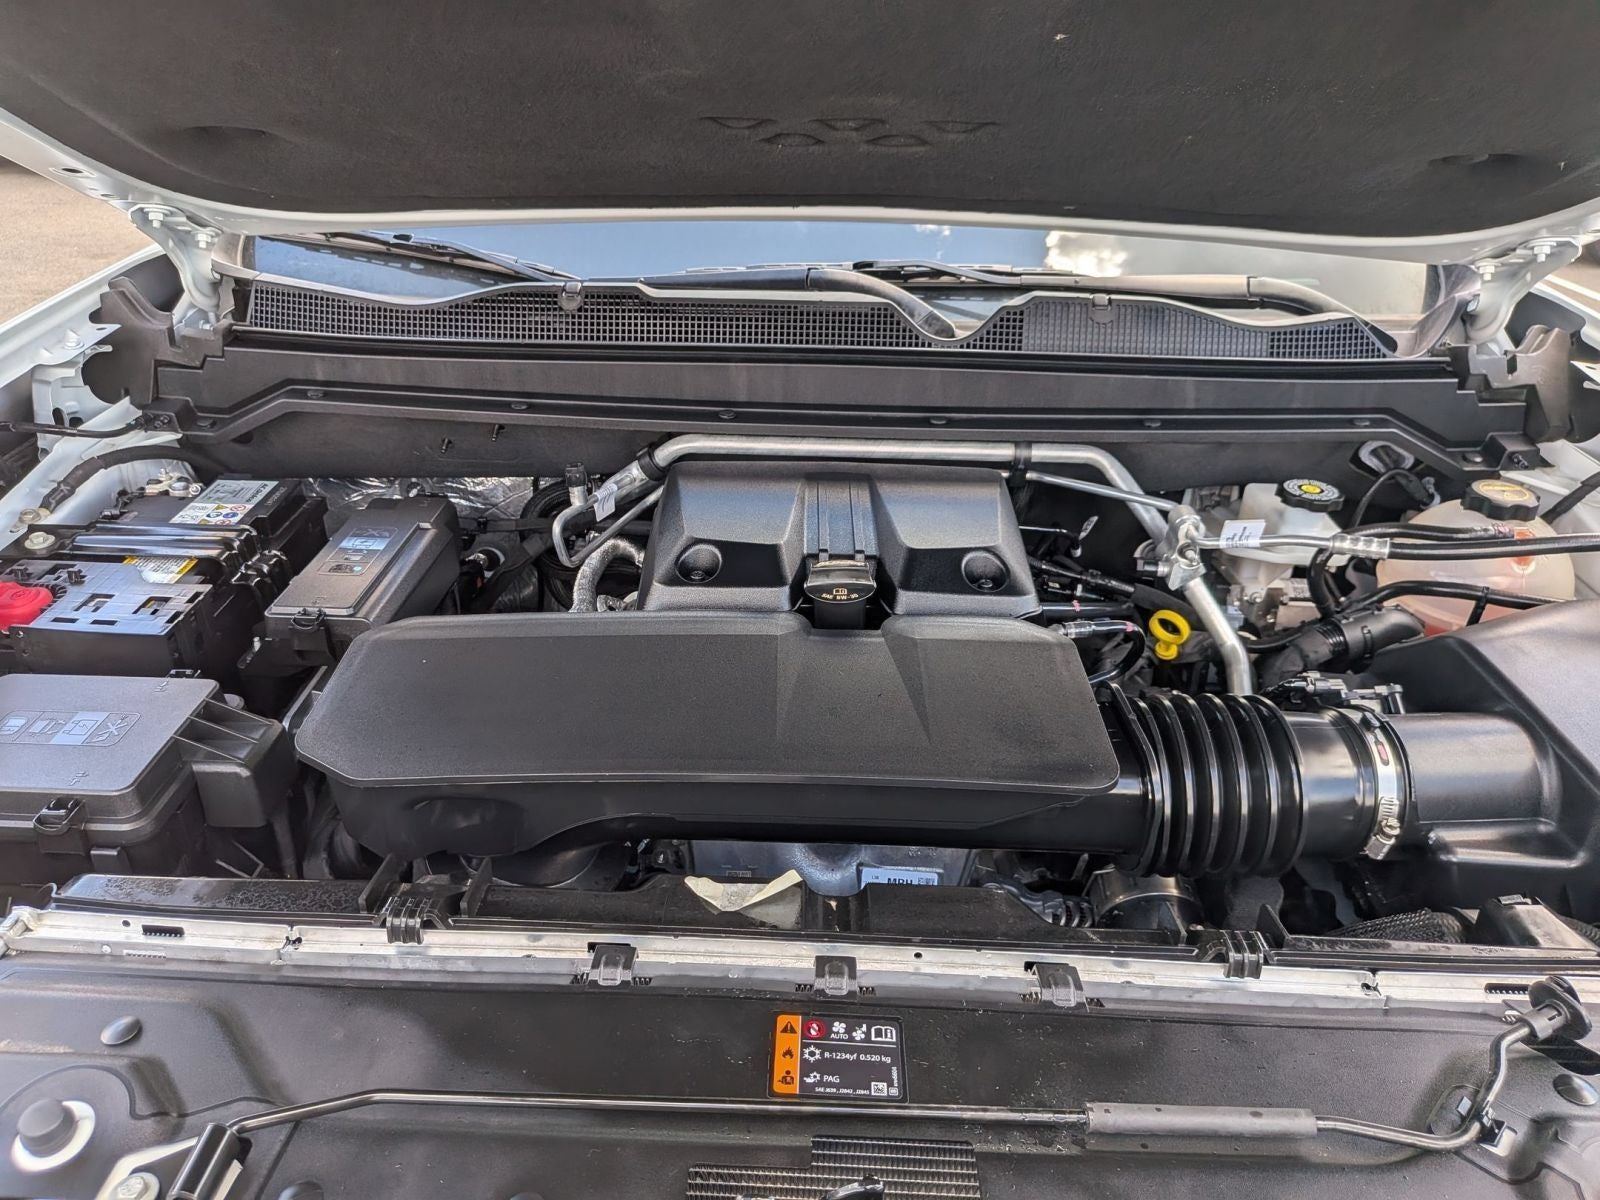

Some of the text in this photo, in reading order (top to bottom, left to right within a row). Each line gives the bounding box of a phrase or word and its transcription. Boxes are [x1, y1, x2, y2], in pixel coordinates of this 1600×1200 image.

[824, 1052, 857, 1060] R-1234yf
[881, 1055, 891, 1063] kg
[823, 1075, 840, 1083] PAG
